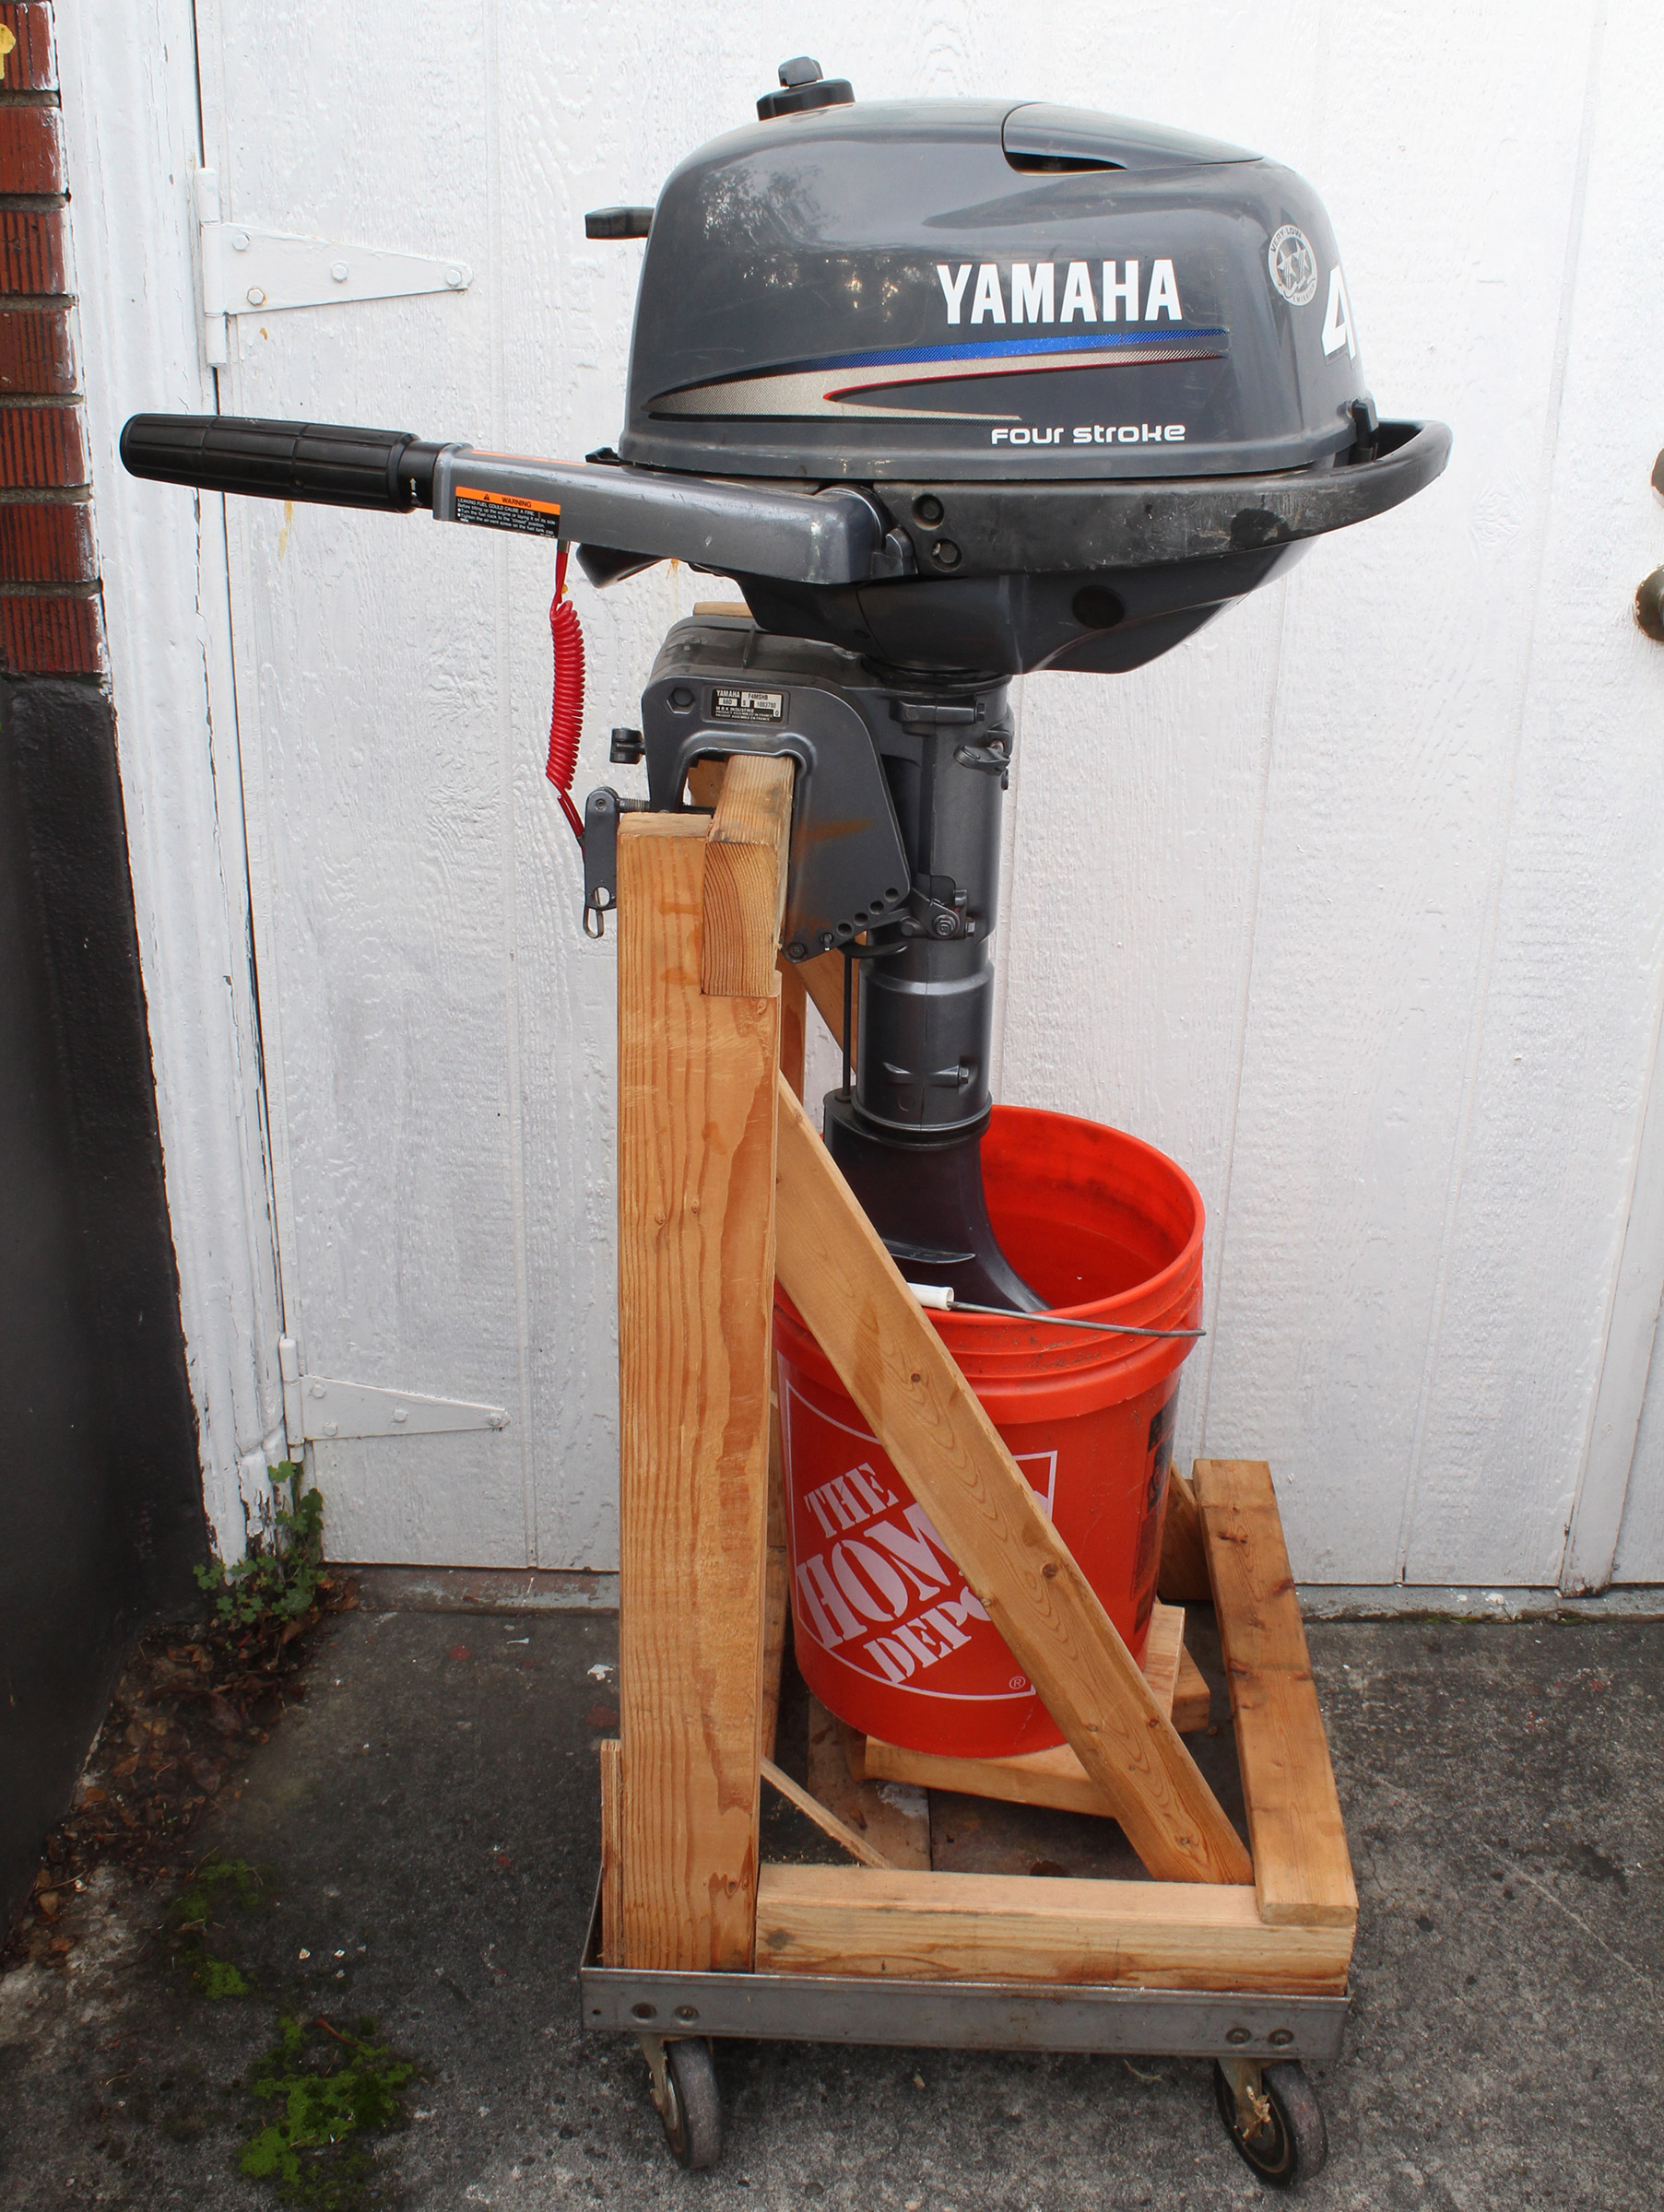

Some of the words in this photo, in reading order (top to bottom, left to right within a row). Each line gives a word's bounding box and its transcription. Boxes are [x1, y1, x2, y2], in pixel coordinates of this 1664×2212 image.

[936, 258, 1183, 324] YAMAHA
[1321, 265, 1357, 360] 4
[502, 497, 531, 508] WARNING
[716, 689, 740, 698] YAMAHA
[803, 1462, 900, 1539] THE
